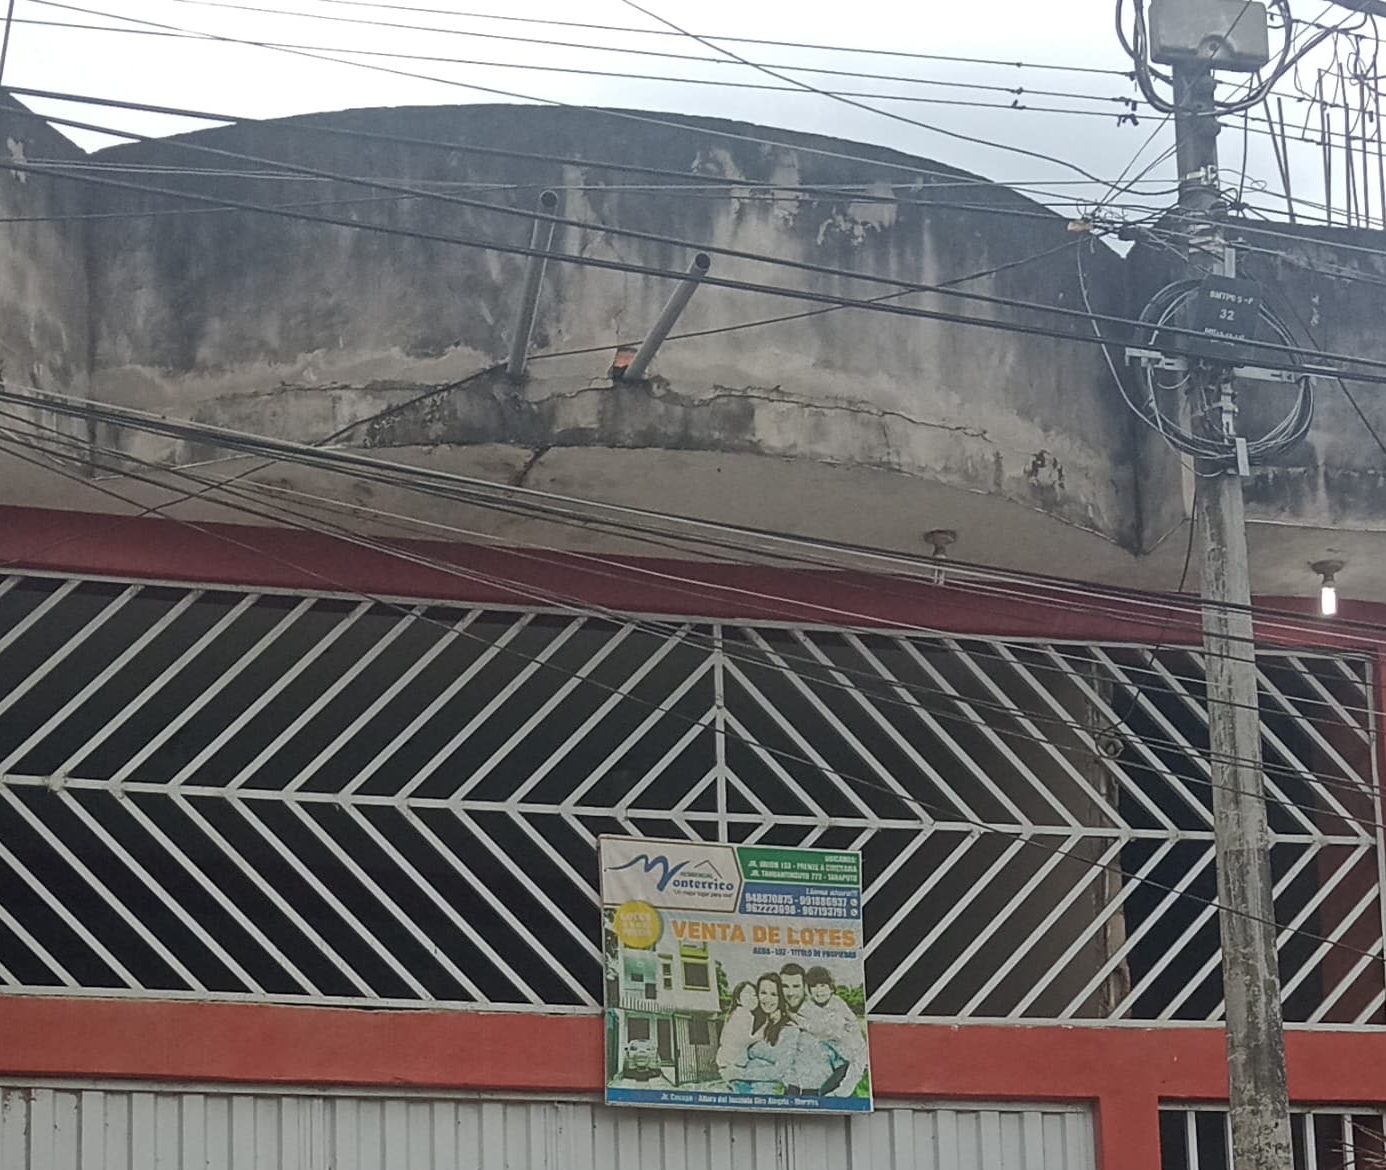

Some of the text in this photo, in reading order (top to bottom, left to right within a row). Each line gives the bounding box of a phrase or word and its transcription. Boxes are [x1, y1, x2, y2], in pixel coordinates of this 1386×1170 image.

[1219, 309, 1235, 320] 32
[671, 920, 746, 942] VENTA
[752, 926, 781, 944] DE
[787, 927, 856, 948] LOTES
